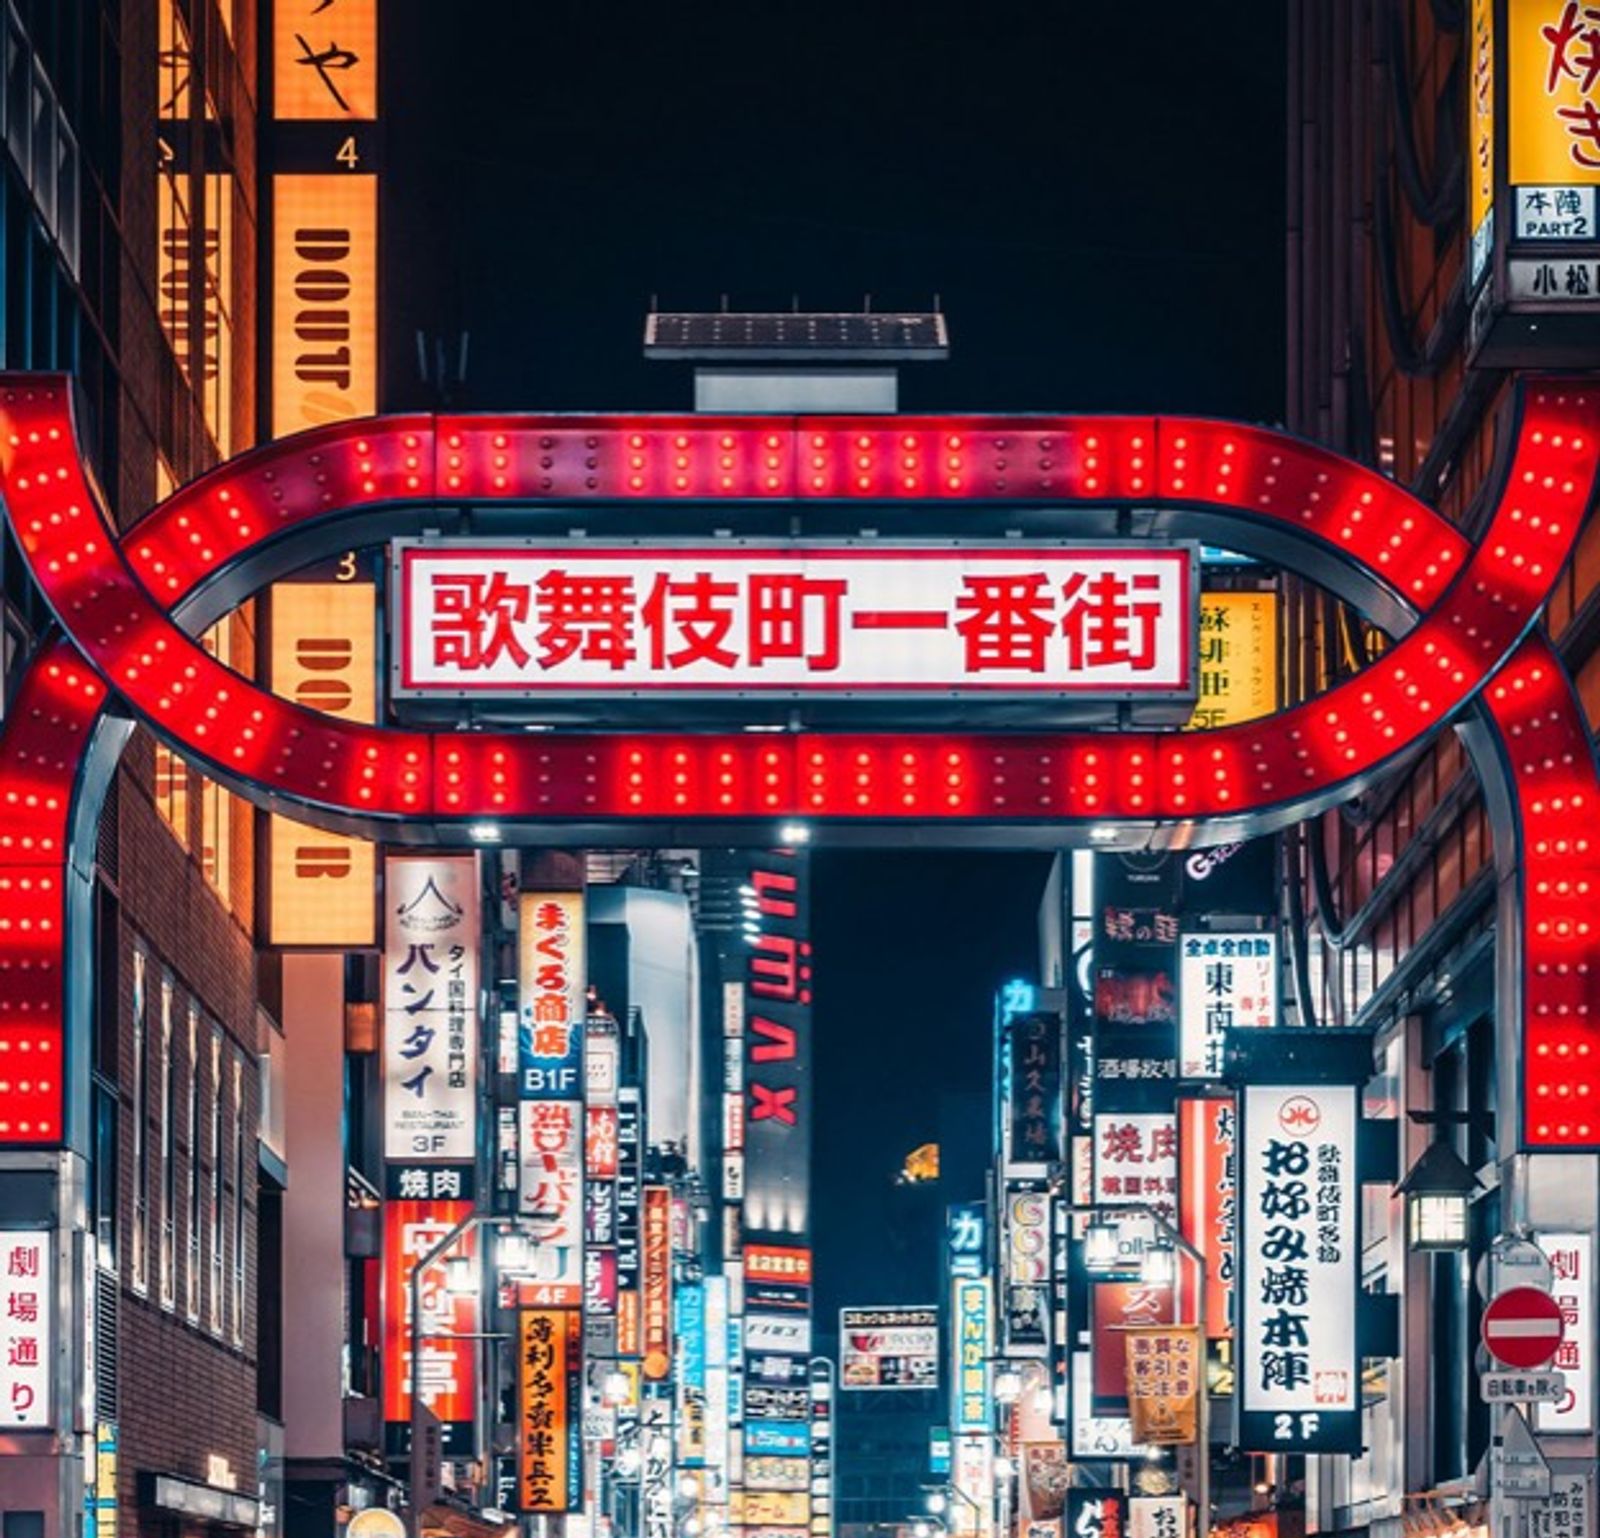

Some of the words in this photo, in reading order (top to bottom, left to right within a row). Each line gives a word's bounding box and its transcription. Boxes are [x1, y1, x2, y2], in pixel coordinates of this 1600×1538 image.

[336, 137, 359, 169] 4
[1526, 216, 1587, 236] PART2
[1533, 264, 1600, 296] 小松
[336, 551, 357, 581] 3
[431, 569, 1162, 672] 歌舞伎町一番街
[396, 943, 441, 1099] バンタイ
[524, 1069, 577, 1091] B1F
[412, 1136, 447, 1152] 3F
[400, 1169, 461, 1197] 焼肉
[1317, 1143, 1342, 1264] 歌舞伎町名物
[1260, 1138, 1311, 1391] お好み焼本陣
[536, 1287, 568, 1302] 4F
[7, 1245, 39, 1411] 劇場通り
[1487, 1379, 1559, 1397] 自転車を除く
[1274, 1413, 1321, 1440] 2F
